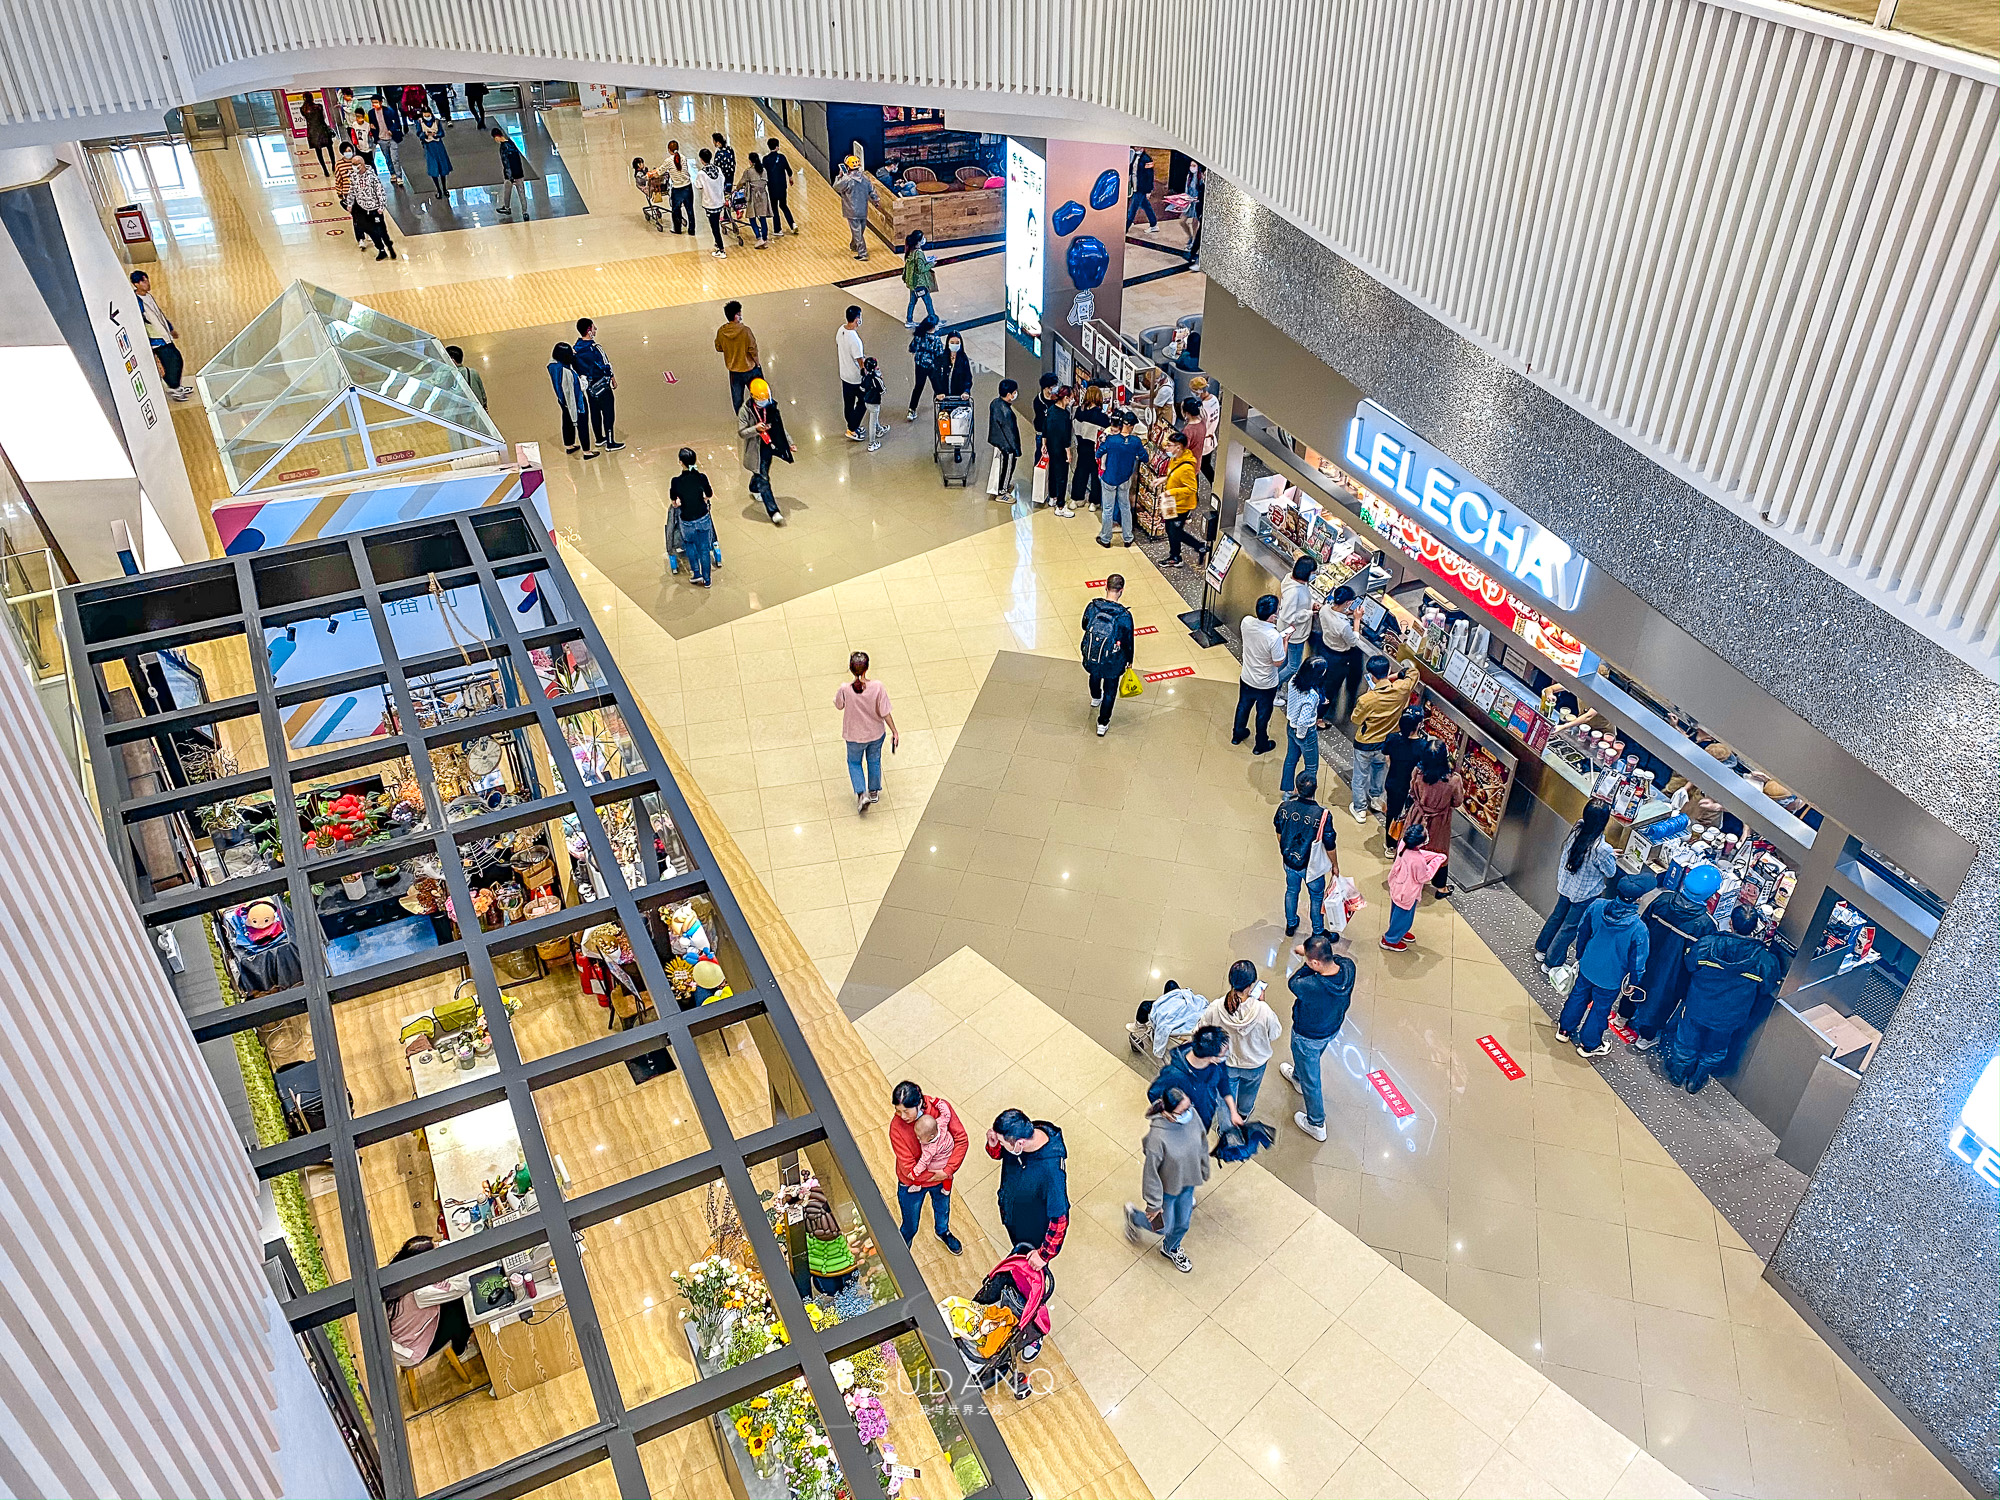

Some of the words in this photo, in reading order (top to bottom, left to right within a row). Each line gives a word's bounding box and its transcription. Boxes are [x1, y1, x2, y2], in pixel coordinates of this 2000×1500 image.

[1346, 416, 1571, 598] LELECHA
[1480, 1036, 1517, 1077] 请间隔1米以上
[1371, 1071, 1407, 1113] 请间隔1米以上
